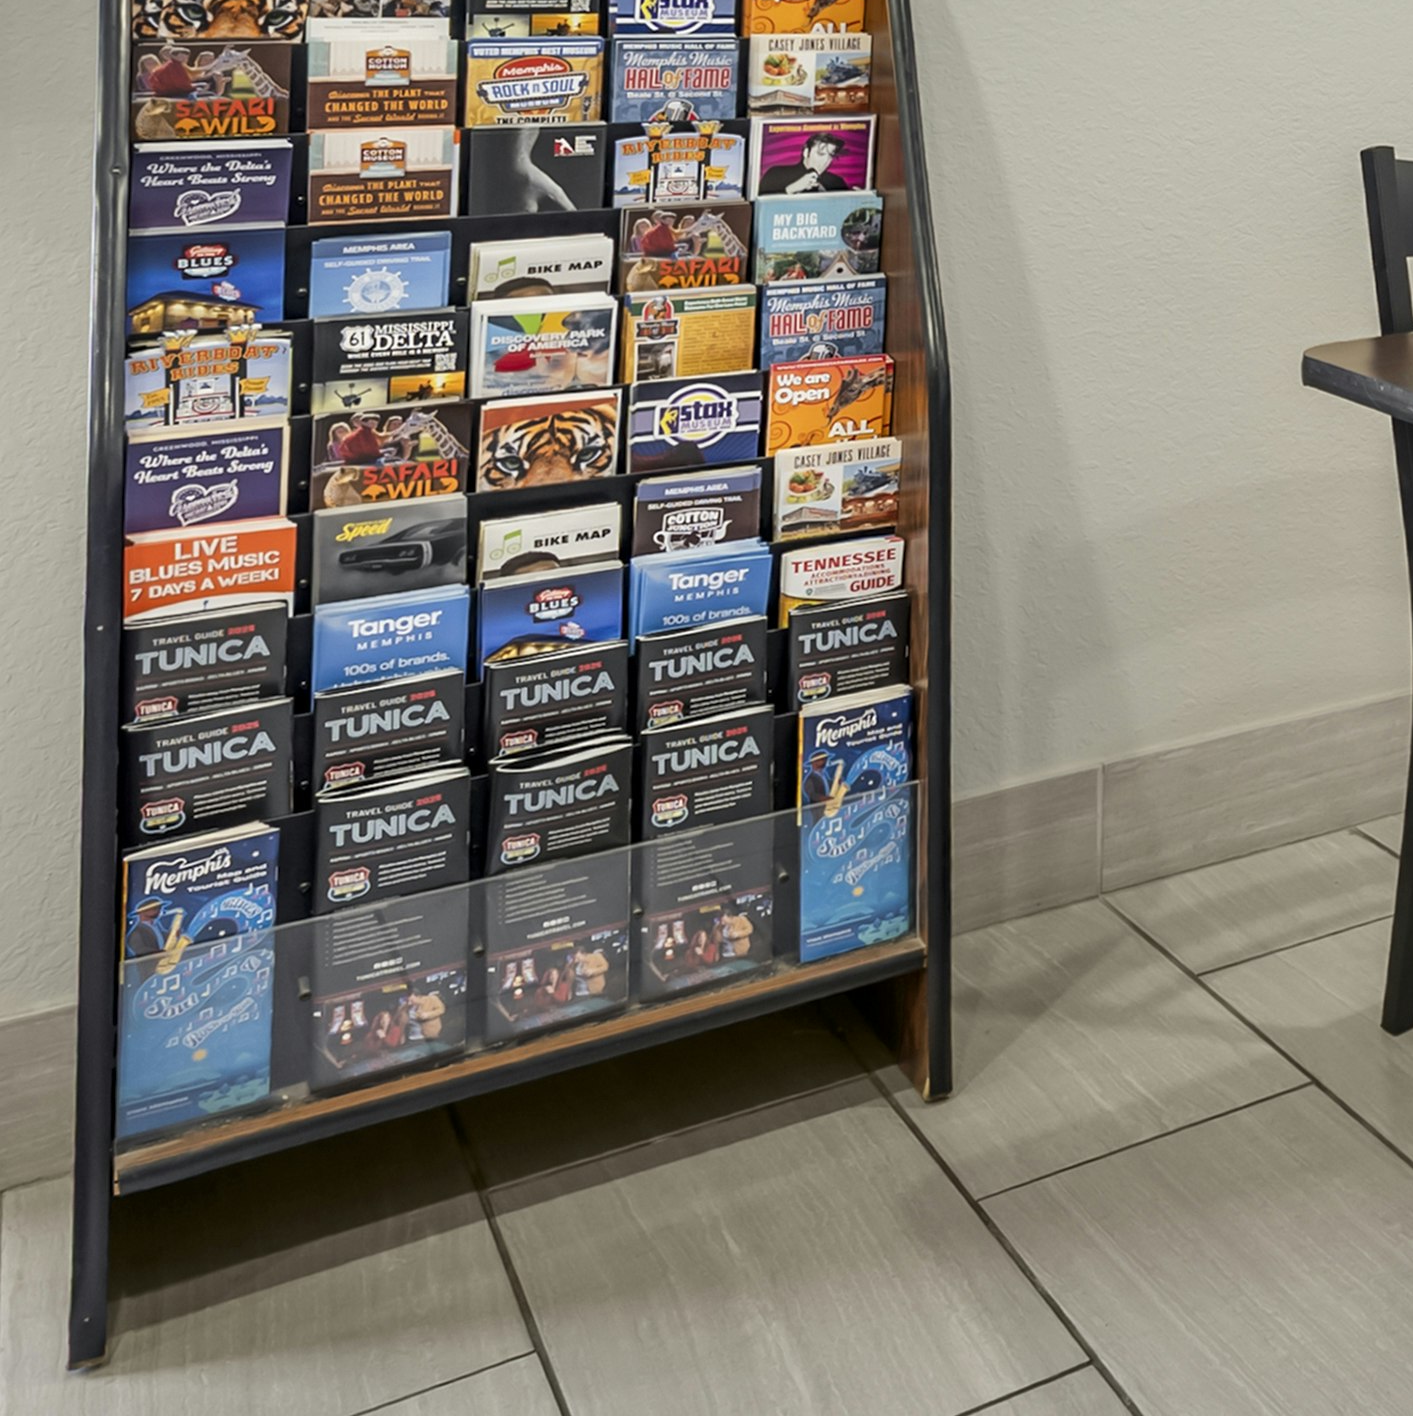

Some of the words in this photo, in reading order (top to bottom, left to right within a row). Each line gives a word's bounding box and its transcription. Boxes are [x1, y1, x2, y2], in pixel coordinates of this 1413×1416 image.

[660, 8, 708, 16] MUSEUM
[768, 39, 794, 51] CASEY
[799, 39, 825, 51] JONES
[829, 38, 861, 50] VILLAGE
[367, 57, 407, 65] COTTON
[623, 51, 688, 67] Memphis
[690, 52, 732, 66] Music
[624, 68, 662, 90] HALL
[175, 98, 274, 118] SAFARI
[325, 101, 379, 112] CHANGED
[384, 100, 405, 110] THE
[409, 99, 448, 110] WORLD
[148, 161, 197, 174] Where
[201, 162, 222, 172] the
[141, 175, 185, 187] Heart
[187, 174, 228, 186] Beats
[231, 173, 276, 186] Strong
[773, 214, 792, 226] MY
[796, 213, 818, 225] BIG
[772, 225, 836, 240] BACKYARD
[343, 244, 388, 253] MEMPHIS
[390, 243, 415, 251] AREA
[177, 256, 233, 269] BLUES
[528, 264, 562, 274] BIKE
[568, 261, 603, 271] MAP
[828, 420, 874, 437] ALL
[336, 518, 393, 541] Speed
[174, 536, 238, 560] LIVE
[129, 562, 203, 585] BLUES
[207, 551, 280, 573] MUSIC
[792, 548, 897, 574] TENNESSEE
[130, 588, 141, 601] 7
[148, 582, 197, 599] DAYS
[200, 578, 214, 591] A
[218, 568, 279, 588] WEEK!
[668, 568, 749, 591] Tanger
[850, 575, 896, 592] GUIDE
[674, 587, 739, 602] MEMPHIS
[348, 610, 442, 638] Tanger
[662, 613, 690, 625] 100s
[693, 611, 707, 621] of
[709, 607, 752, 619] brands.
[152, 634, 192, 646] TRAVEL
[194, 629, 225, 639] GUIDE
[357, 631, 433, 651] MEMPHIS
[799, 620, 898, 654] TUNICA
[135, 635, 270, 675] TUNICA
[649, 643, 754, 681] TUNICA
[500, 671, 615, 710] TUNICA
[325, 700, 450, 742] TUNICA
[815, 714, 877, 748] Memphis
[139, 731, 276, 777] TUNICA
[652, 736, 760, 775] TUNICA
[504, 774, 619, 815] TUNICA
[330, 803, 456, 847] TUNICA
[144, 854, 232, 895] Memphis
